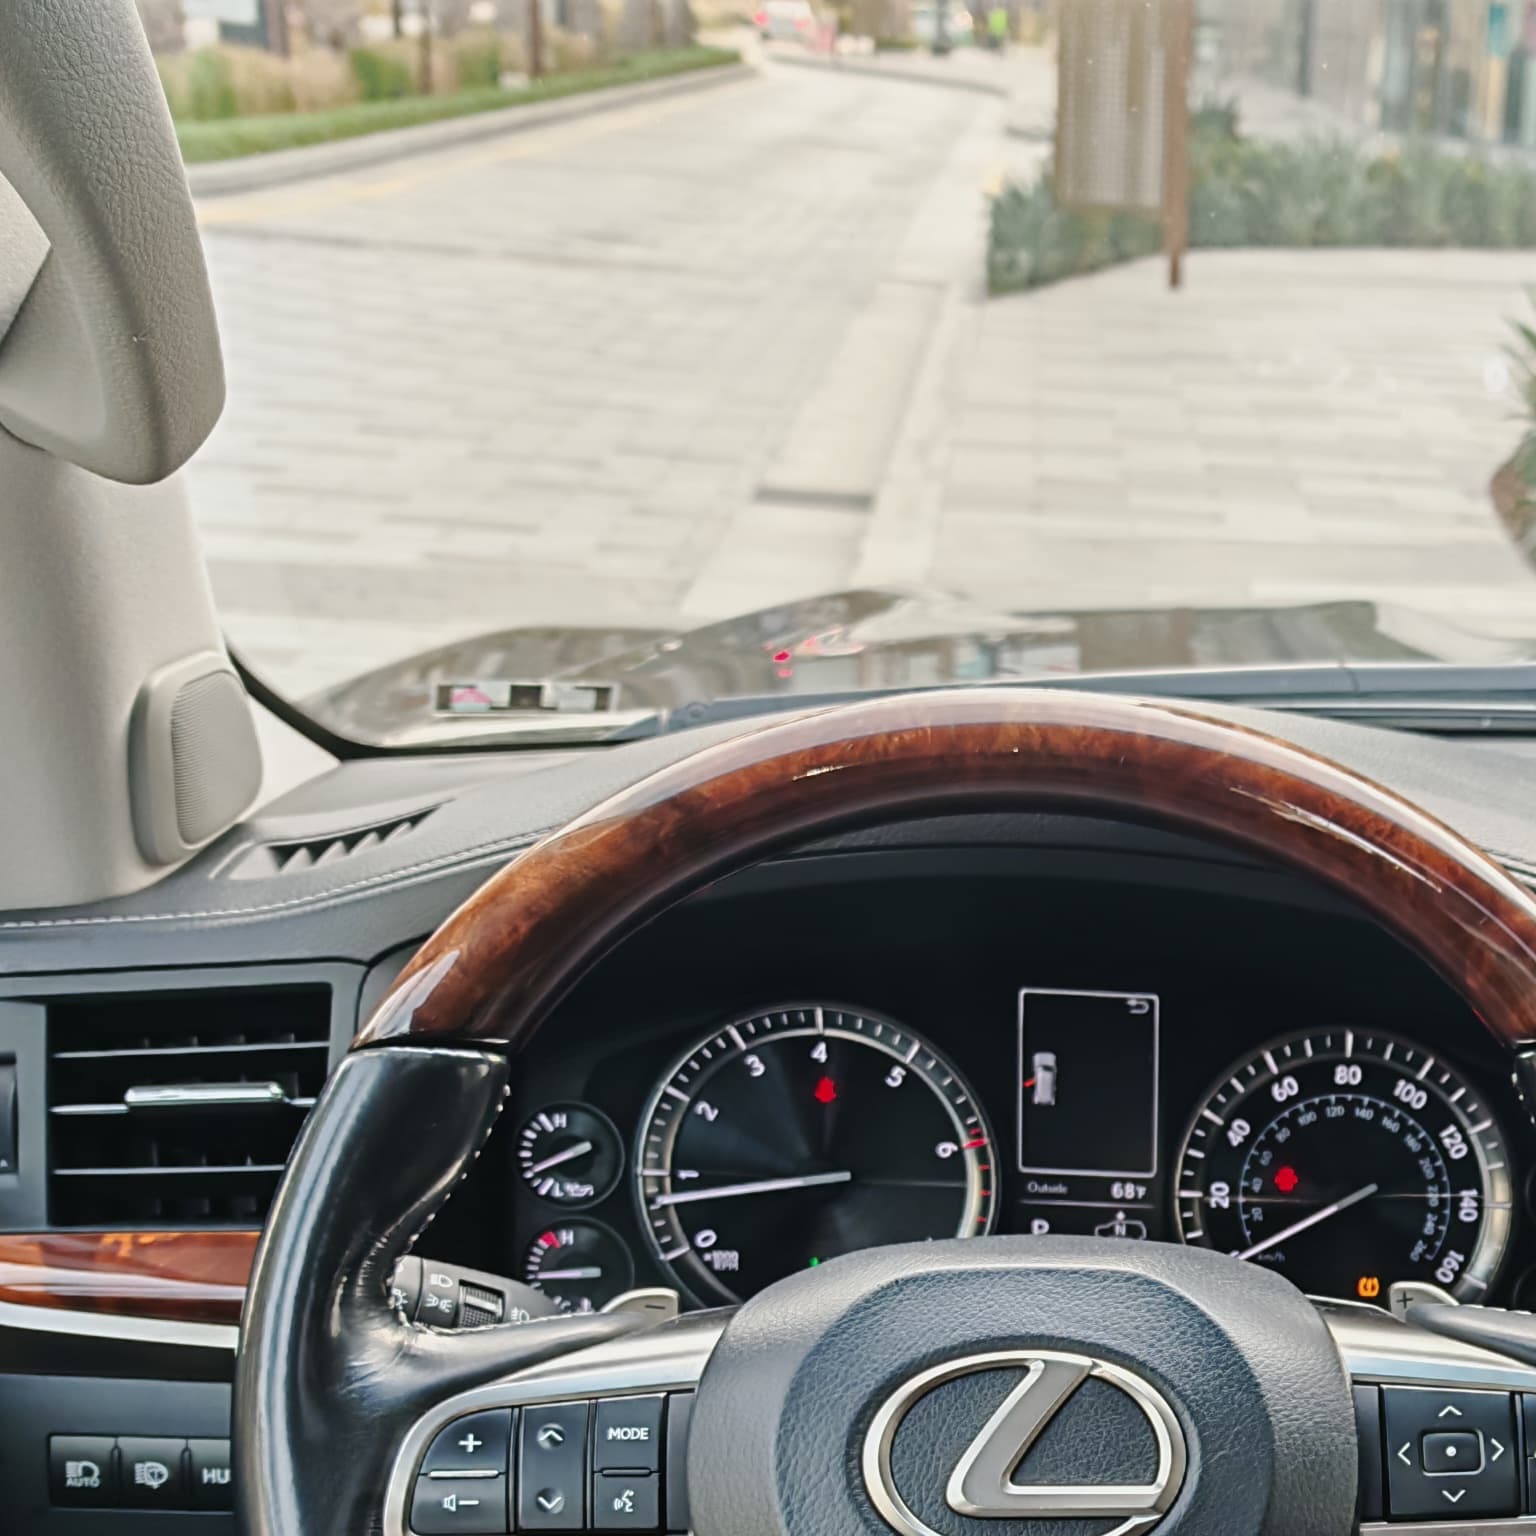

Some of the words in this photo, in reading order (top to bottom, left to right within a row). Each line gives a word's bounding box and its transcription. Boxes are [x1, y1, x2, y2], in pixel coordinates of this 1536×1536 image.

[811, 1041, 828, 1063] 4
[743, 1053, 766, 1077] 3
[1333, 1063, 1363, 1086] 80
[884, 1064, 907, 1089] 5
[1270, 1075, 1300, 1103] 60
[1392, 1078, 1428, 1110] 100
[694, 1100, 719, 1122] 2
[1324, 1104, 1346, 1118] 120
[1225, 1117, 1252, 1148] 40
[1438, 1123, 1469, 1161] 120
[935, 1140, 959, 1158] 6
[678, 1167, 699, 1181] 1
[1026, 1181, 1069, 1195] Outside
[1208, 1180, 1232, 1210] 20
[1457, 1188, 1480, 1223] 140
[694, 1228, 718, 1249] 0
[1434, 1249, 1466, 1285] 160
[607, 1426, 650, 1442] MODE
[65, 1477, 101, 1489] AUTO
[202, 1467, 231, 1485] HU
